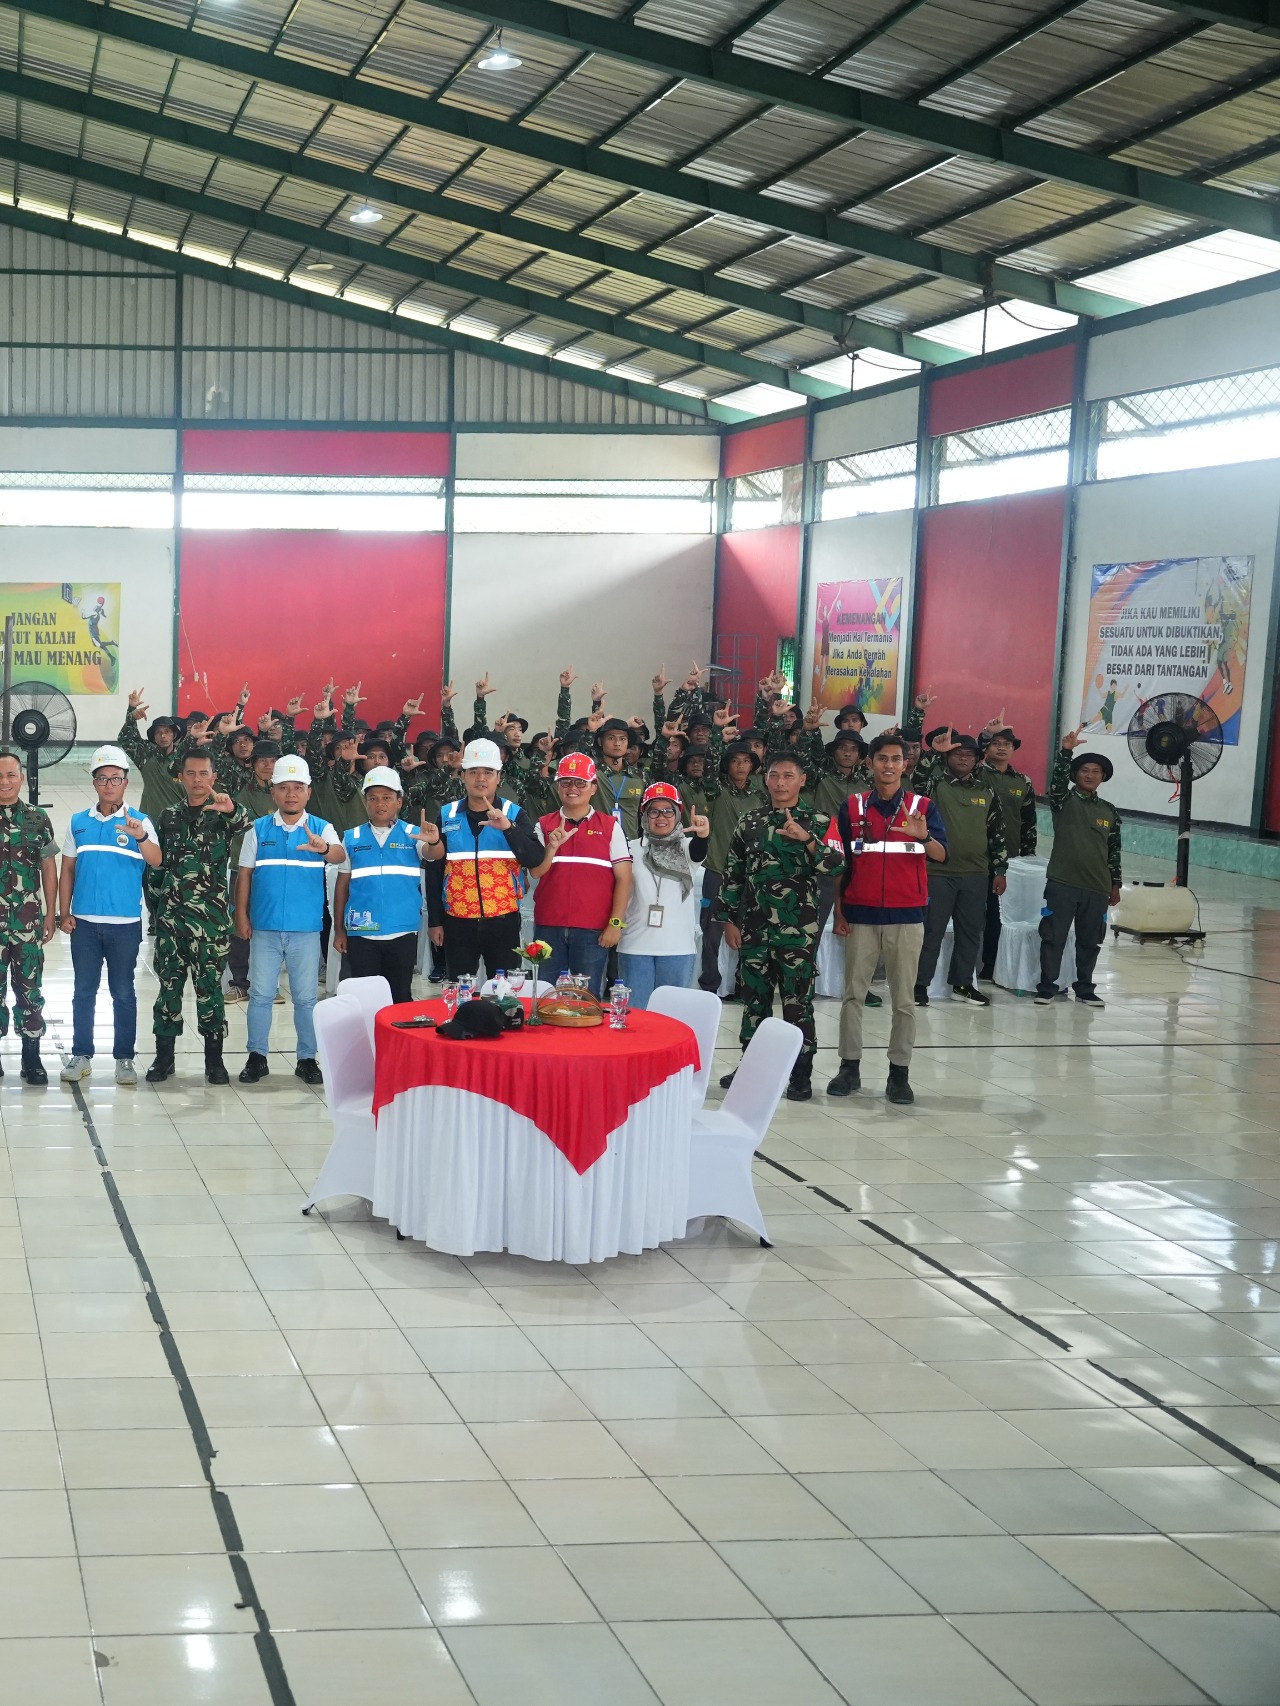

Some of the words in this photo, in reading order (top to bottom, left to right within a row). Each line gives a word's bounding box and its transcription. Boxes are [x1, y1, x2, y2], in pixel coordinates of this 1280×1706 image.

[11, 612, 57, 626] JANGAN
[836, 612, 886, 625] KEMENANGAN
[1120, 607, 1138, 620] JIKA
[1140, 607, 1158, 619] KAU
[1159, 606, 1200, 619] MEMILIKI
[35, 631, 76, 645] KALAH
[828, 632, 852, 644] Menjadi
[864, 632, 893, 643] Termanis
[1099, 626, 1135, 639] SESUATU
[1136, 626, 1164, 638] UNTUK
[1165, 626, 1223, 641] DIBUKTIKAN,
[14, 650, 42, 666] MAU
[47, 650, 102, 666] MENANG
[832, 649, 844, 660] Jika
[846, 649, 863, 660] Anda
[1111, 645, 1134, 657] TIDAK
[1135, 645, 1153, 657] ADA
[1155, 645, 1178, 658] YANG
[1179, 645, 1206, 658] LEBIH
[825, 665, 858, 677] Merasakan
[858, 666, 892, 679] Kekalahan
[1106, 663, 1133, 676] BESAR
[1134, 663, 1155, 676] DARI
[1156, 664, 1209, 678] TANTANGAN
